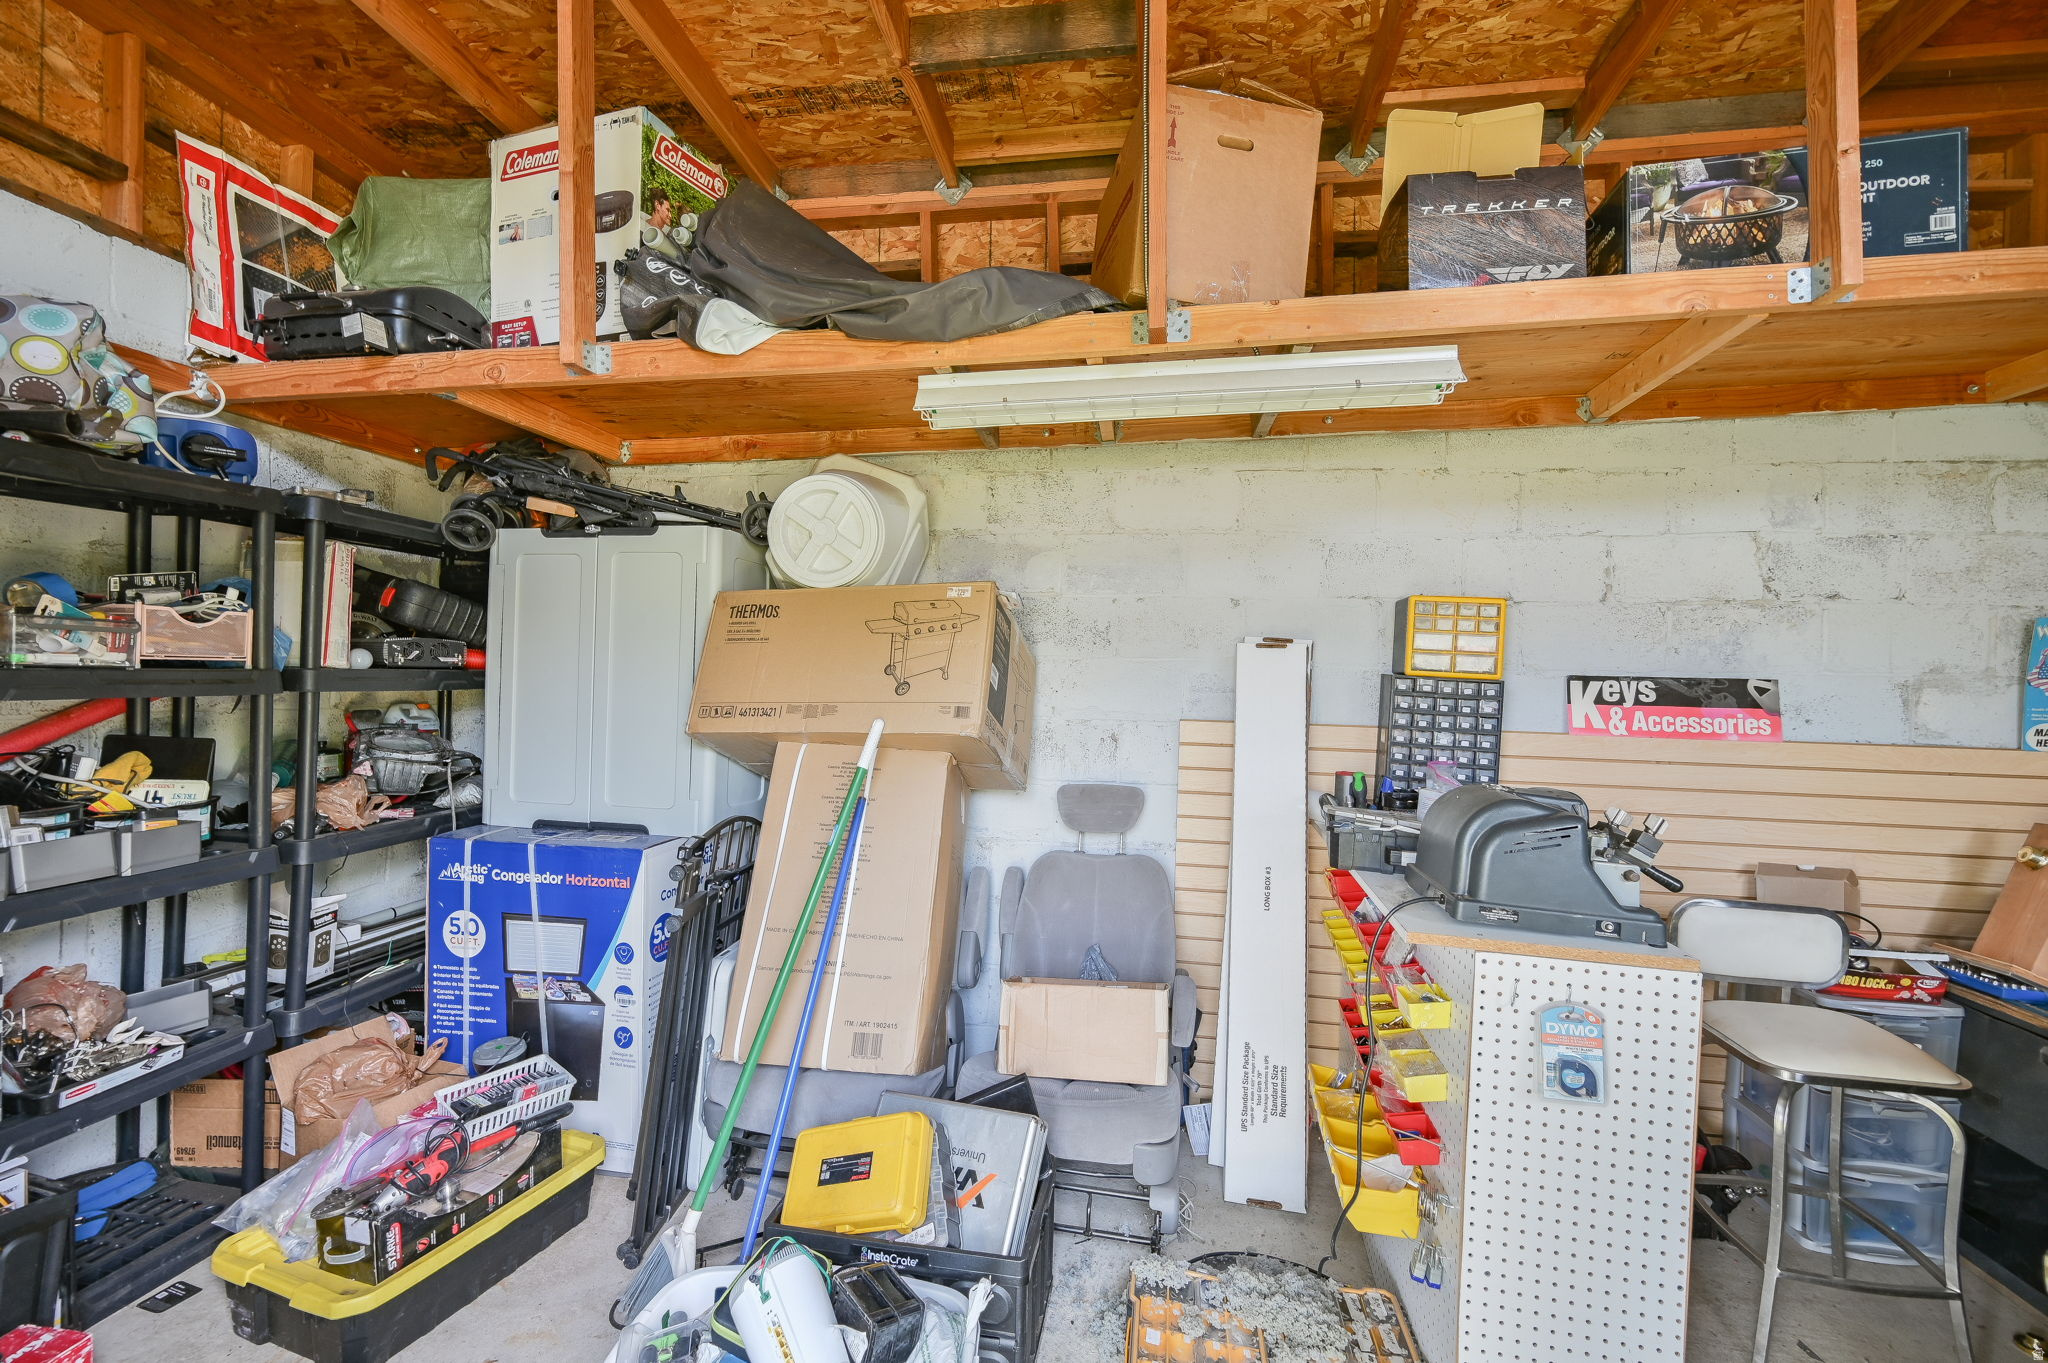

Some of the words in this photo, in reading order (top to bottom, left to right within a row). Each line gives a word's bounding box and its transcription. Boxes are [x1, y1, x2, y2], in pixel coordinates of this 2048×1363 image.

[506, 149, 559, 176] Coleman
[660, 140, 713, 189] Coleman
[1865, 159, 1883, 168] 250
[1861, 192, 1876, 204] IT
[1420, 198, 1573, 216] TREKKER
[1486, 263, 1574, 282] FLY
[514, 321, 527, 329] SETUP
[730, 604, 780, 619] THERMOS
[739, 706, 777, 716] 461313421
[1570, 680, 1657, 729] Keys
[1608, 706, 1628, 736] &
[1632, 710, 1772, 735] Accessories
[453, 862, 488, 874] Arctic
[1266, 866, 1272, 874] #3
[492, 868, 563, 884] Congeador
[565, 874, 631, 889] Horizontal
[449, 916, 480, 937] 5.0
[1860, 977, 1886, 989] LOCK
[1546, 1022, 1598, 1038] DYMO
[1243, 1042, 1251, 1070] Package
[1279, 1066, 1287, 1118] Requirements
[206, 1135, 242, 1150] tamucil
[868, 1250, 917, 1267] InstaCrate
